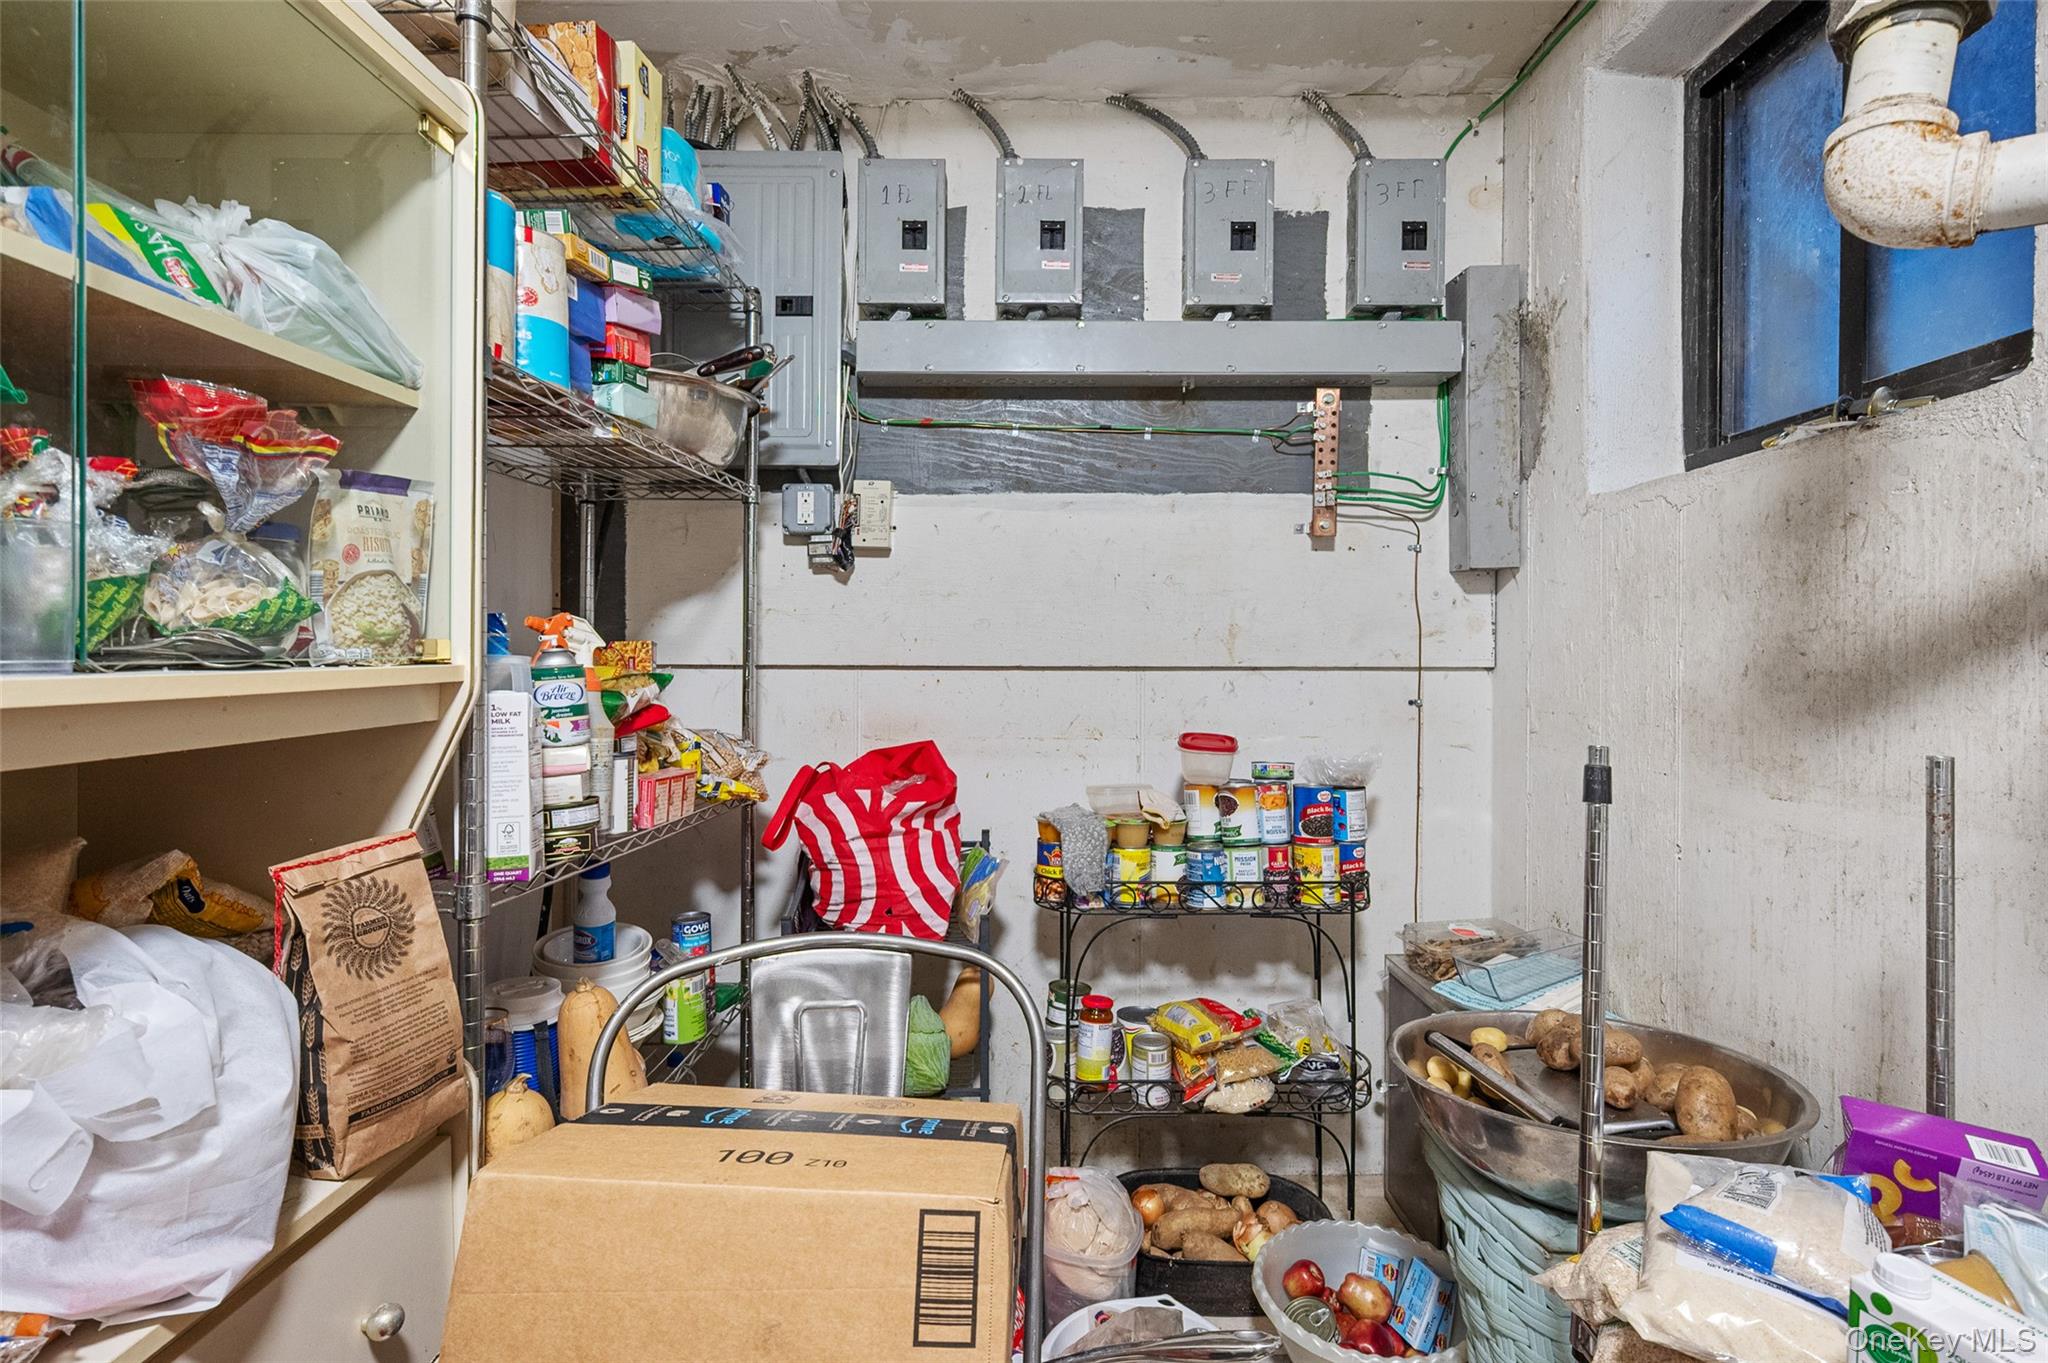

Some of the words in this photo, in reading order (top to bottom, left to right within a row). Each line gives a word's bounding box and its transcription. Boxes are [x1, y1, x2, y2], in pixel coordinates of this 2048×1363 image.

[881, 184, 890, 205] 1
[1017, 184, 1032, 205] 2
[1203, 181, 1216, 205] 3
[1375, 183, 1389, 206] 3
[551, 684, 569, 694] Air
[540, 691, 577, 702] Breeze
[1306, 806, 1324, 815] Black
[1041, 867, 1058, 876] Chick
[1342, 862, 1359, 870] Black
[355, 915, 387, 930] FARMER
[683, 921, 709, 935] GOYA
[356, 922, 389, 937] GROUND
[717, 1148, 795, 1166] 100
[804, 1157, 848, 1169] Z10
[1972, 1166, 1995, 1179] (454g)
[1996, 1174, 2006, 1182] LB
[2011, 1178, 2023, 1186] WT
[2023, 1181, 2039, 1190] NET
[1932, 1274, 1950, 1287] USE
[1951, 1285, 1993, 1309] BEFORE
